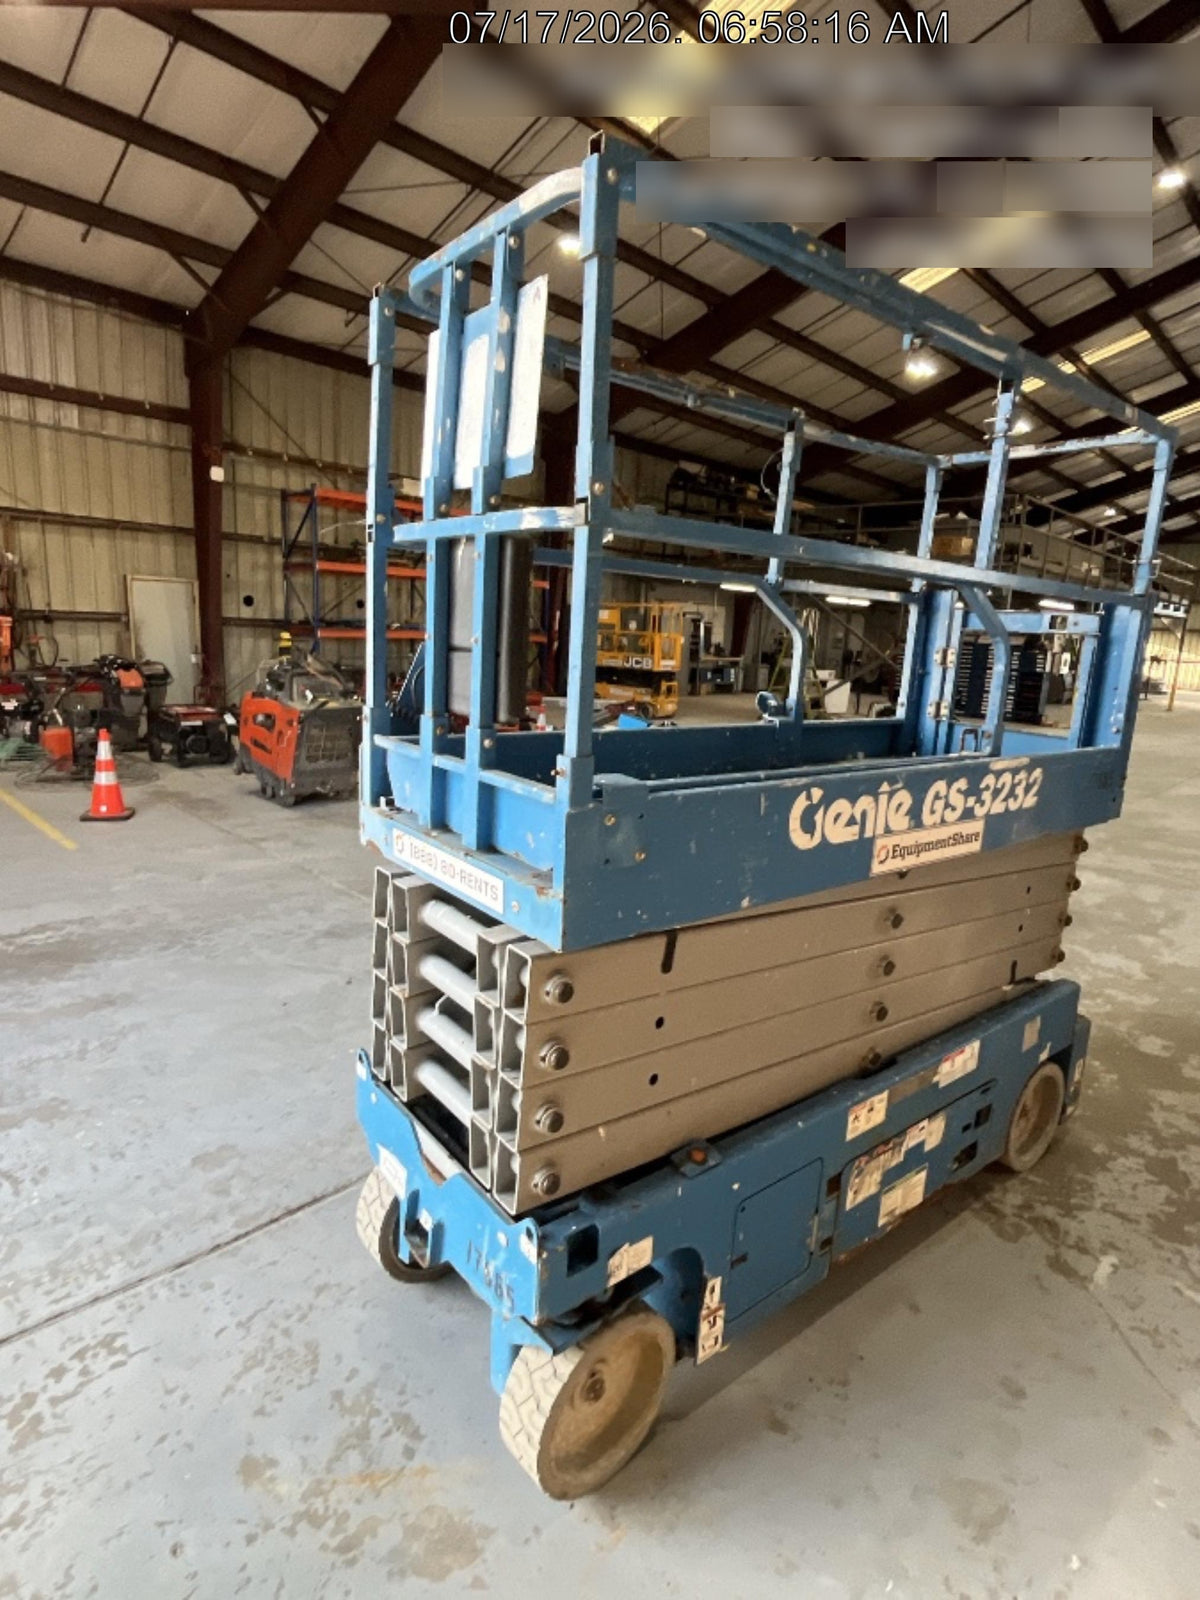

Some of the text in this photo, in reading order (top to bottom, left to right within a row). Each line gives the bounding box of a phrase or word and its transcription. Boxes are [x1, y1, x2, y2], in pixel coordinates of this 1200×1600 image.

[623, 656, 653, 670] JCB
[788, 767, 1043, 850] Genie GS-3232
[890, 830, 981, 861] EquipmentShare
